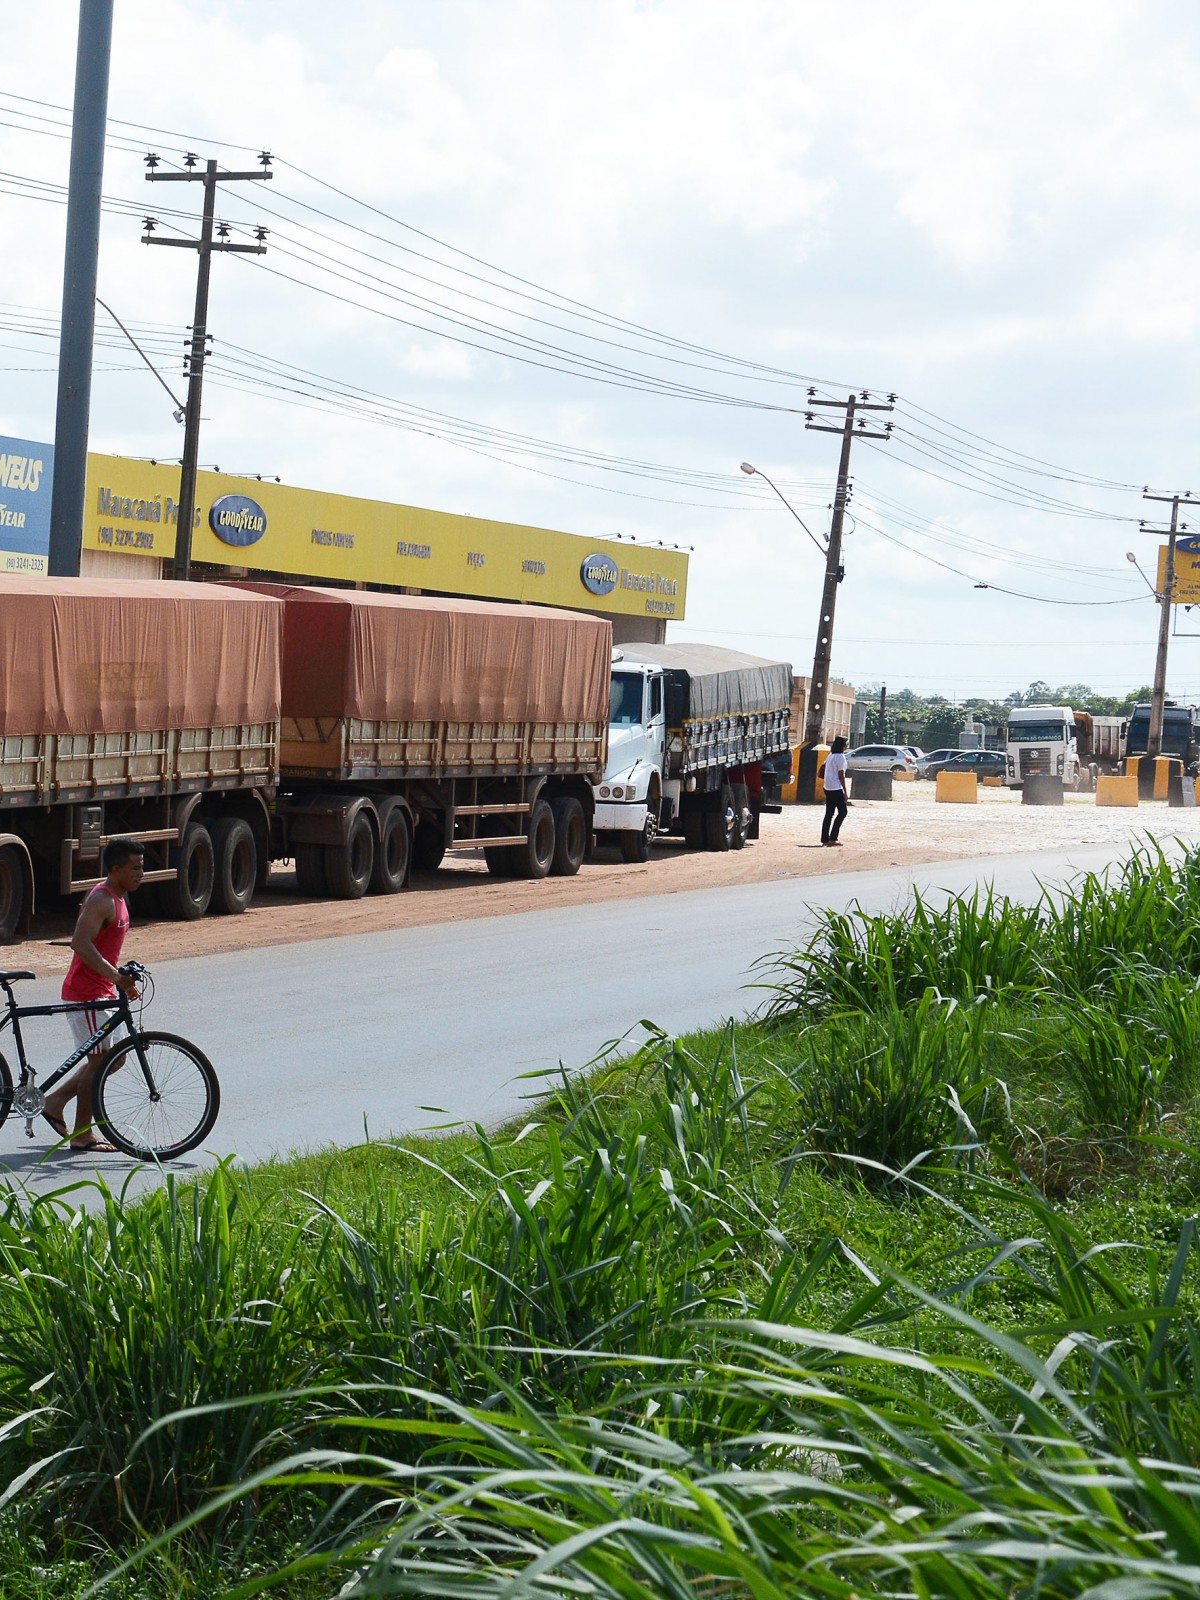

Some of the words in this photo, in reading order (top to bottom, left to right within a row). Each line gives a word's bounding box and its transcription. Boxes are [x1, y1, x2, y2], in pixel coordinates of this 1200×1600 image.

[6, 558, 16, 569] (98)
[16, 558, 44, 571] 3241-2325
[57, 1029, 105, 1074] monaco
